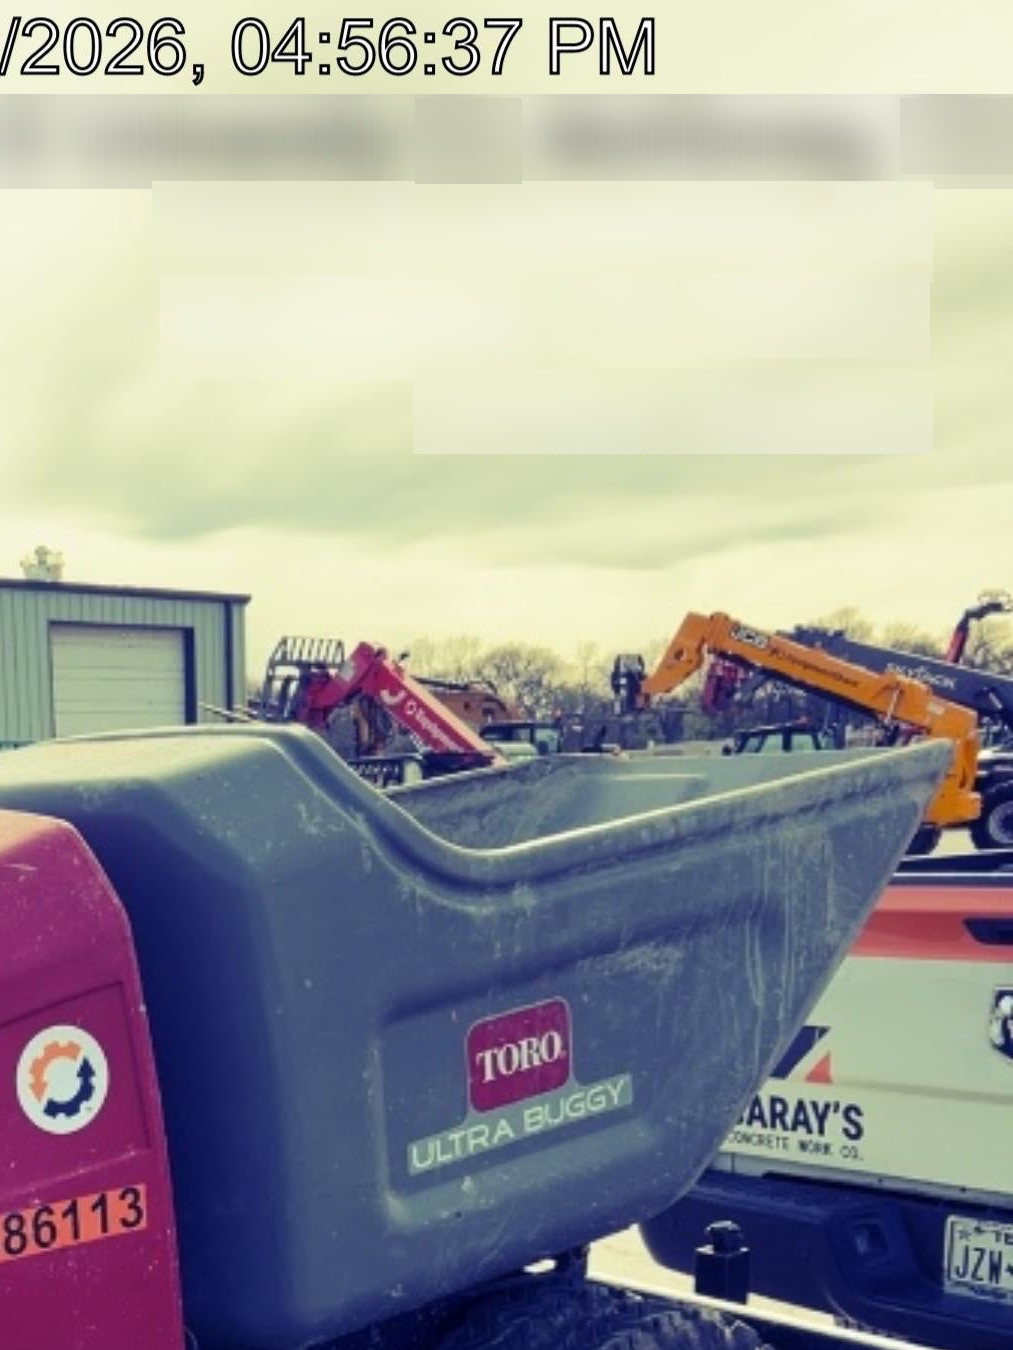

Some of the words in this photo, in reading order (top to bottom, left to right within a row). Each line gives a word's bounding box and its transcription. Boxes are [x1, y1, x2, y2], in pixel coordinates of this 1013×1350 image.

[475, 1030, 564, 1083] TORO
[412, 1118, 516, 1169] ULTRA
[523, 1079, 626, 1132] BUGGY
[737, 1093, 864, 1141] ARAY'S
